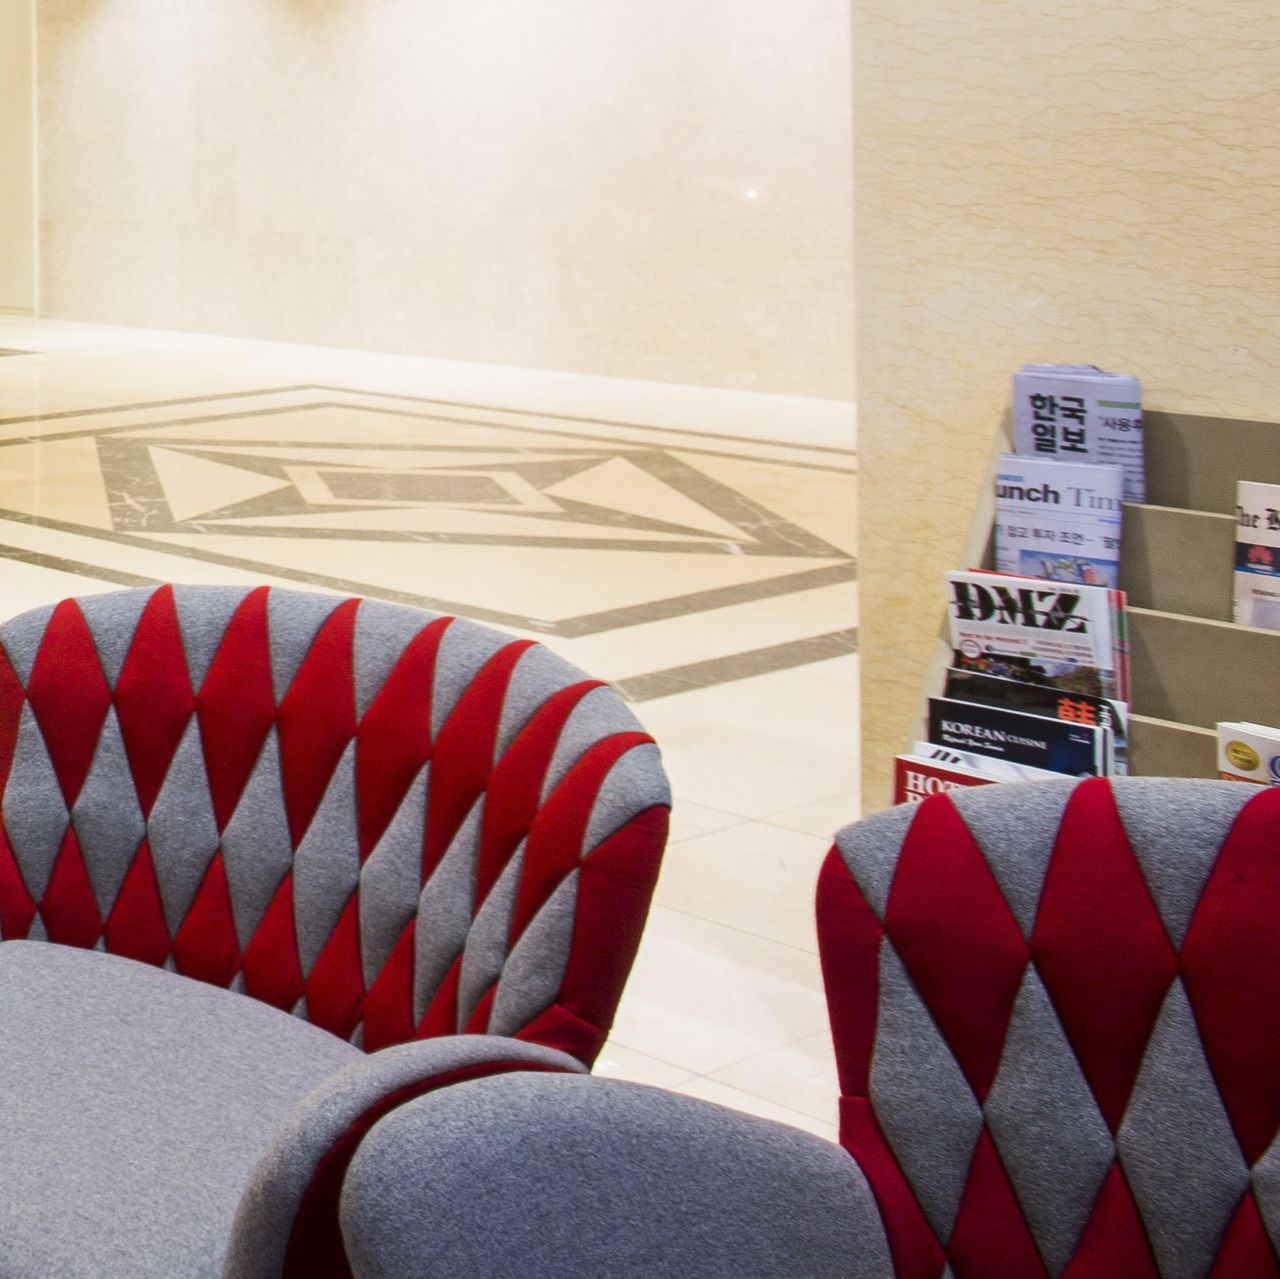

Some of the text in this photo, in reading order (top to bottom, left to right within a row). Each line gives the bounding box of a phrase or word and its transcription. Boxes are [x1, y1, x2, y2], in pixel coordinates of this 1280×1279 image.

[1028, 393, 1088, 425] 한국
[1031, 424, 1088, 453] 일보
[950, 581, 1087, 633] DMZ
[940, 720, 1006, 742] KOREAN
